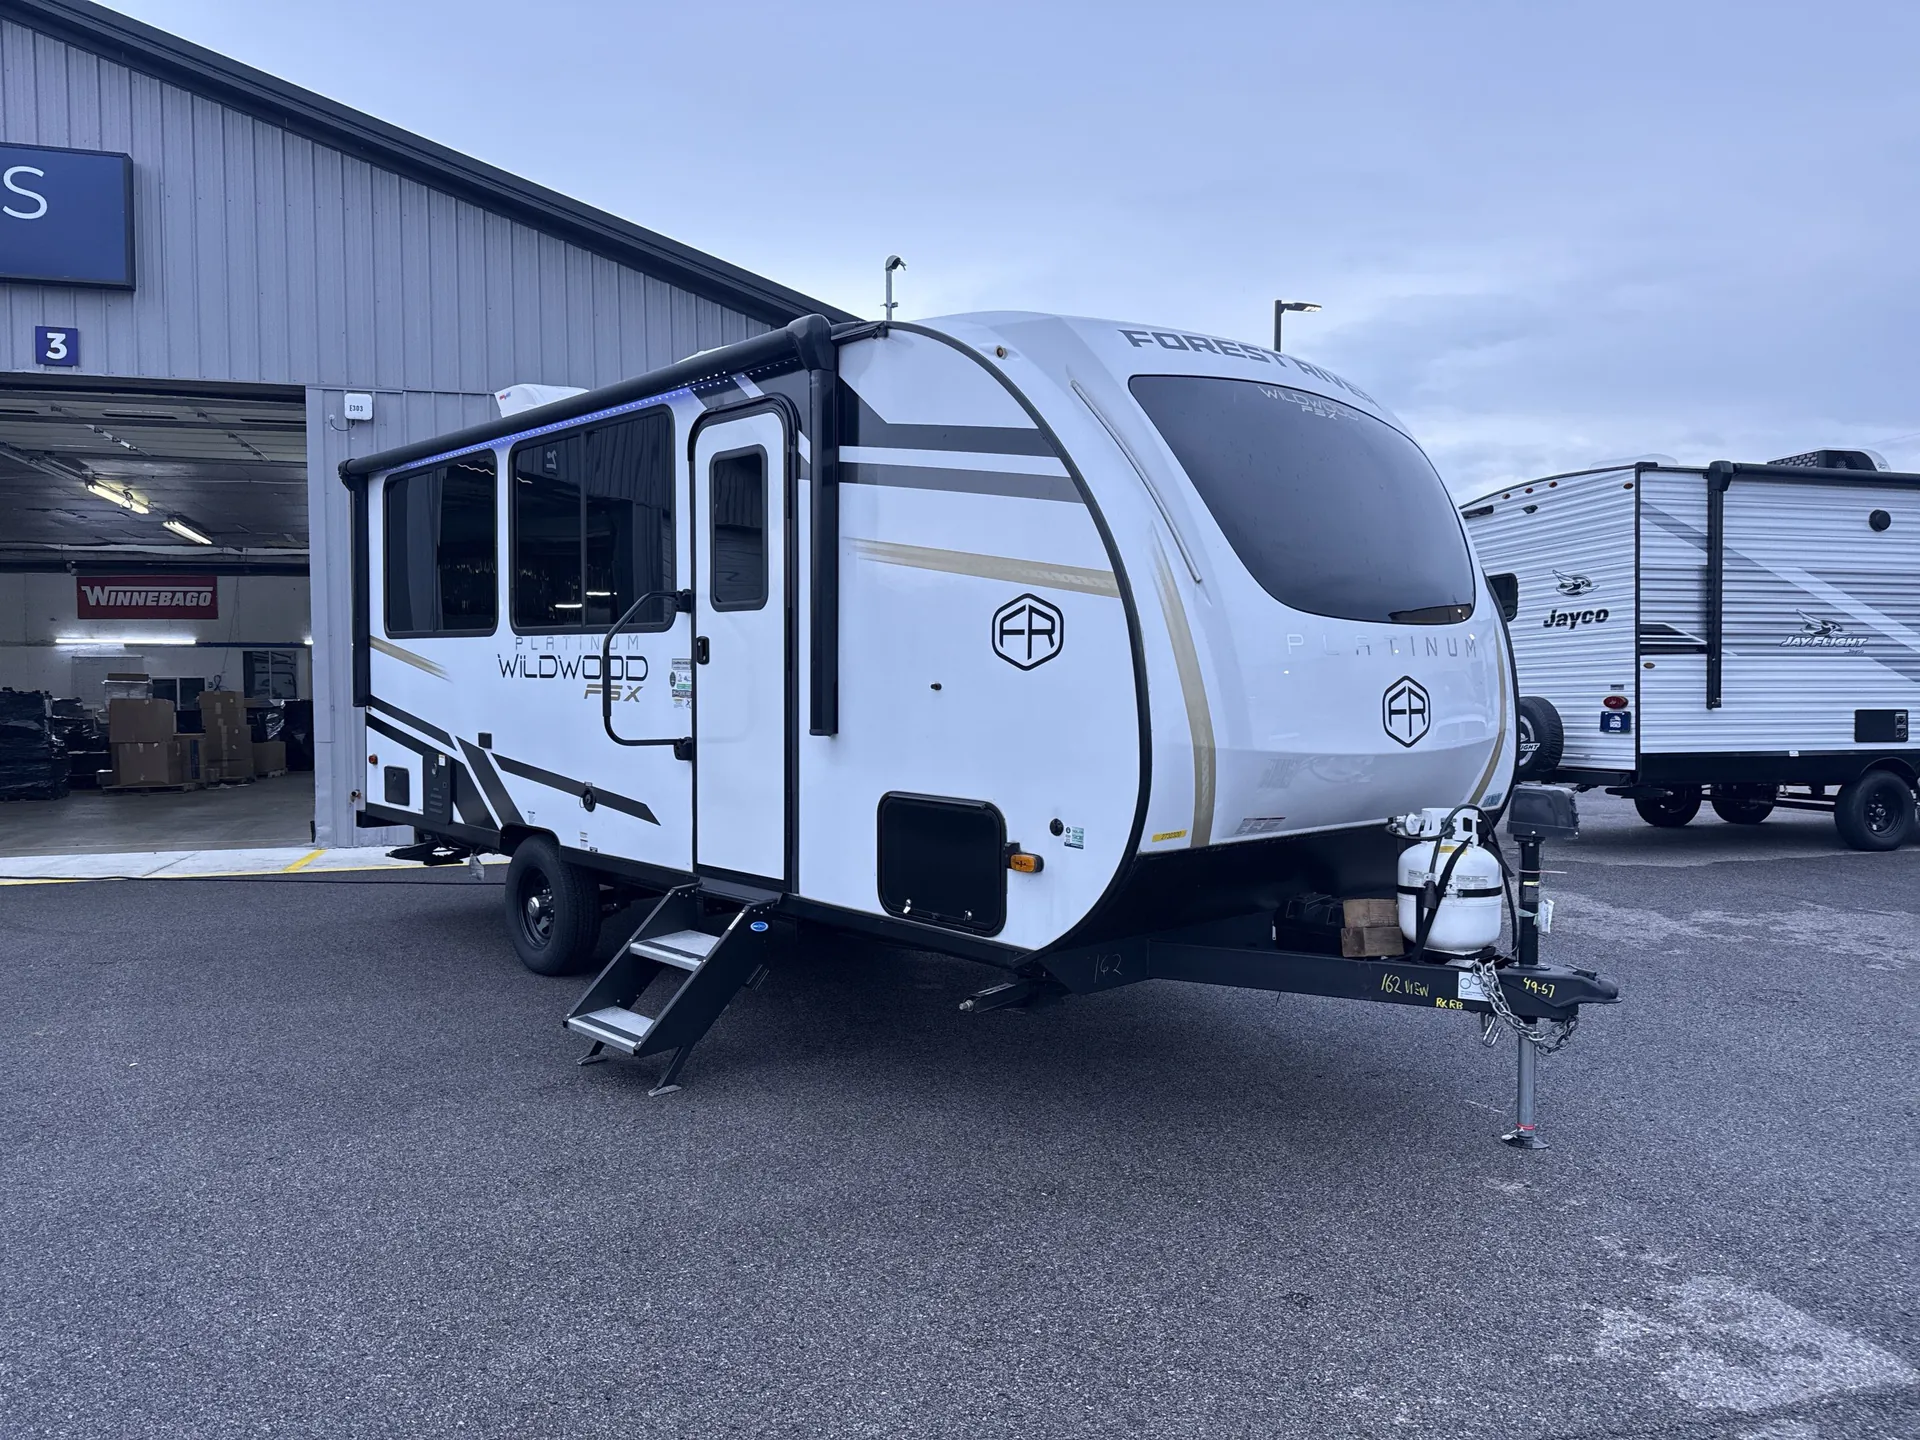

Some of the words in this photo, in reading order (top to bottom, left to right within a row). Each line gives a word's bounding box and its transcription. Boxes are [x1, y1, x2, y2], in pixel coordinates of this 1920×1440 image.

[45, 332, 68, 360] 3
[1118, 329, 1288, 368] FOREST
[81, 585, 214, 606] WINNEBAGO
[1543, 609, 1609, 630] Jayco
[515, 635, 639, 651] PLATINUM
[1286, 633, 1477, 658] PLATINUM
[1779, 635, 1811, 647] JAY
[1809, 635, 1869, 648] FLIGHT
[1094, 953, 1123, 983] 162
[1381, 973, 1403, 993] 162
[1404, 980, 1430, 997] VIEW
[1523, 976, 1556, 998] 49-57
